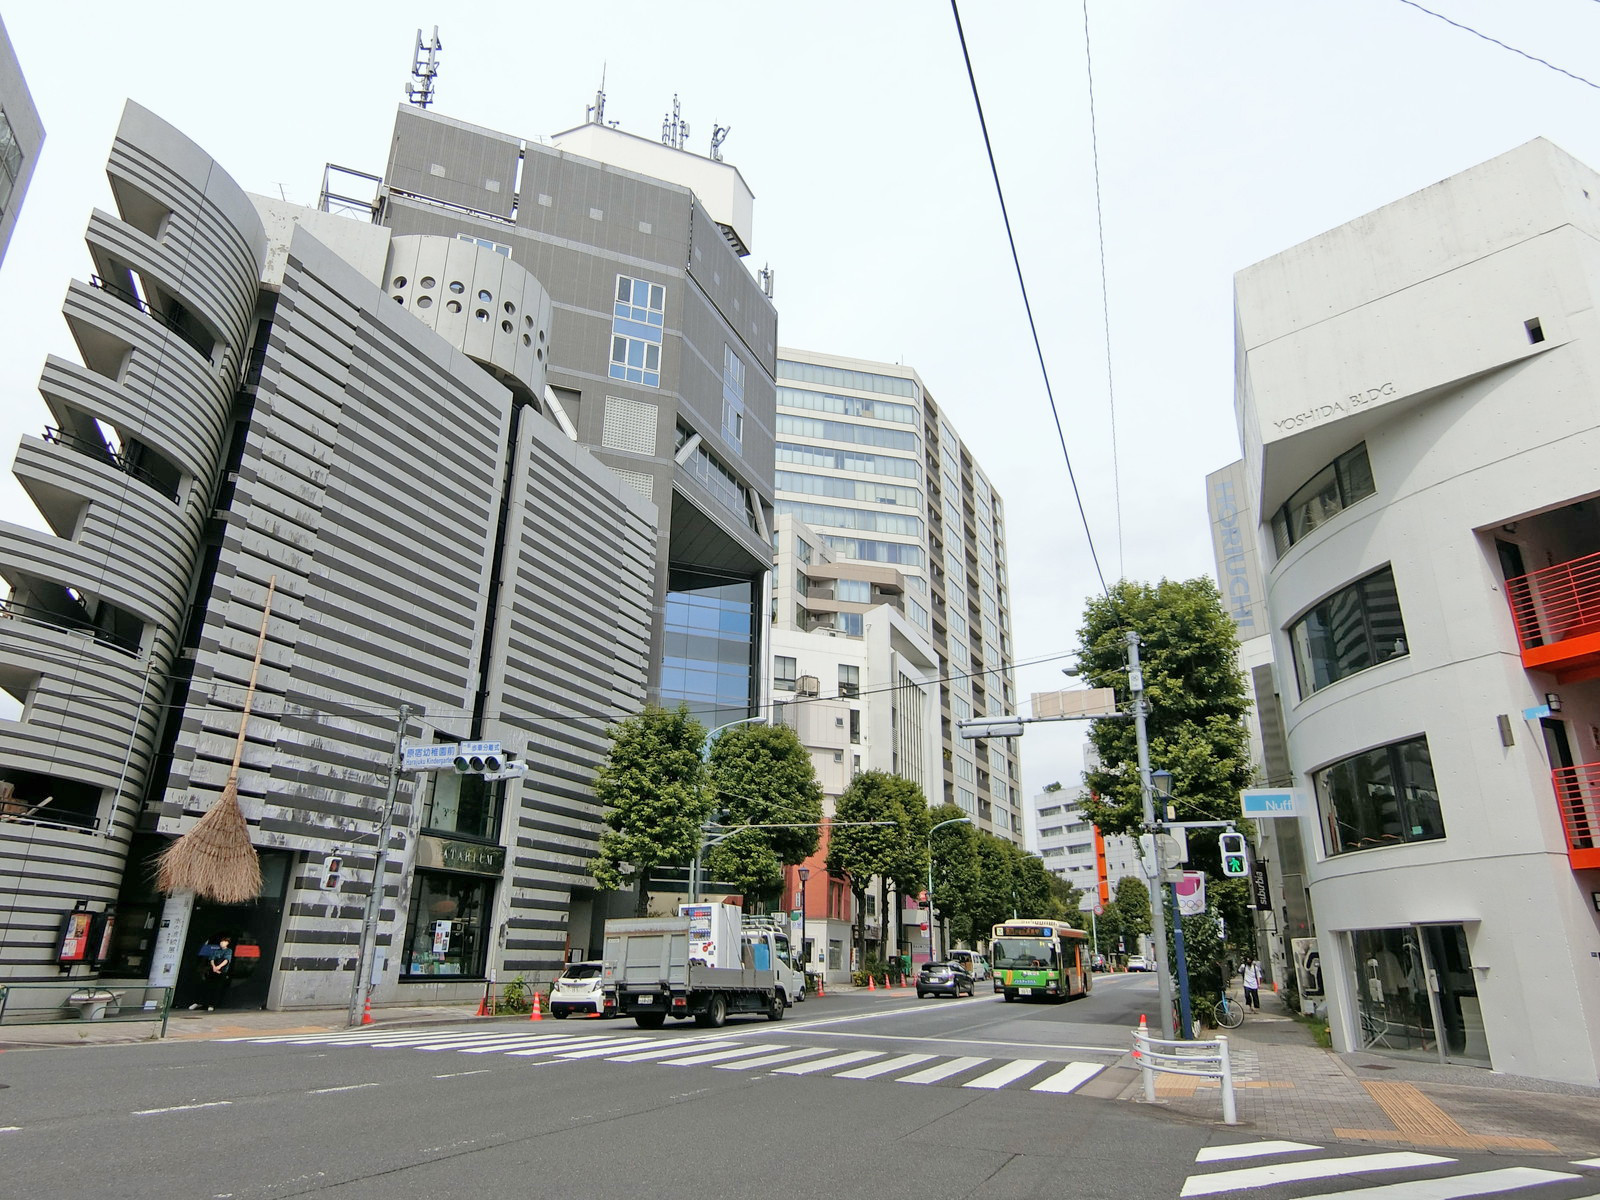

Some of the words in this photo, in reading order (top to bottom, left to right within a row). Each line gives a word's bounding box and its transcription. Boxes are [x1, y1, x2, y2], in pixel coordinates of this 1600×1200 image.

[1273, 401, 1345, 433] YOSHIDA
[1214, 480, 1255, 627] HORIUCHI
[406, 747, 455, 757] 原宿幼稚園前
[1265, 799, 1293, 811] Nuff
[1254, 871, 1267, 905] suburbia
